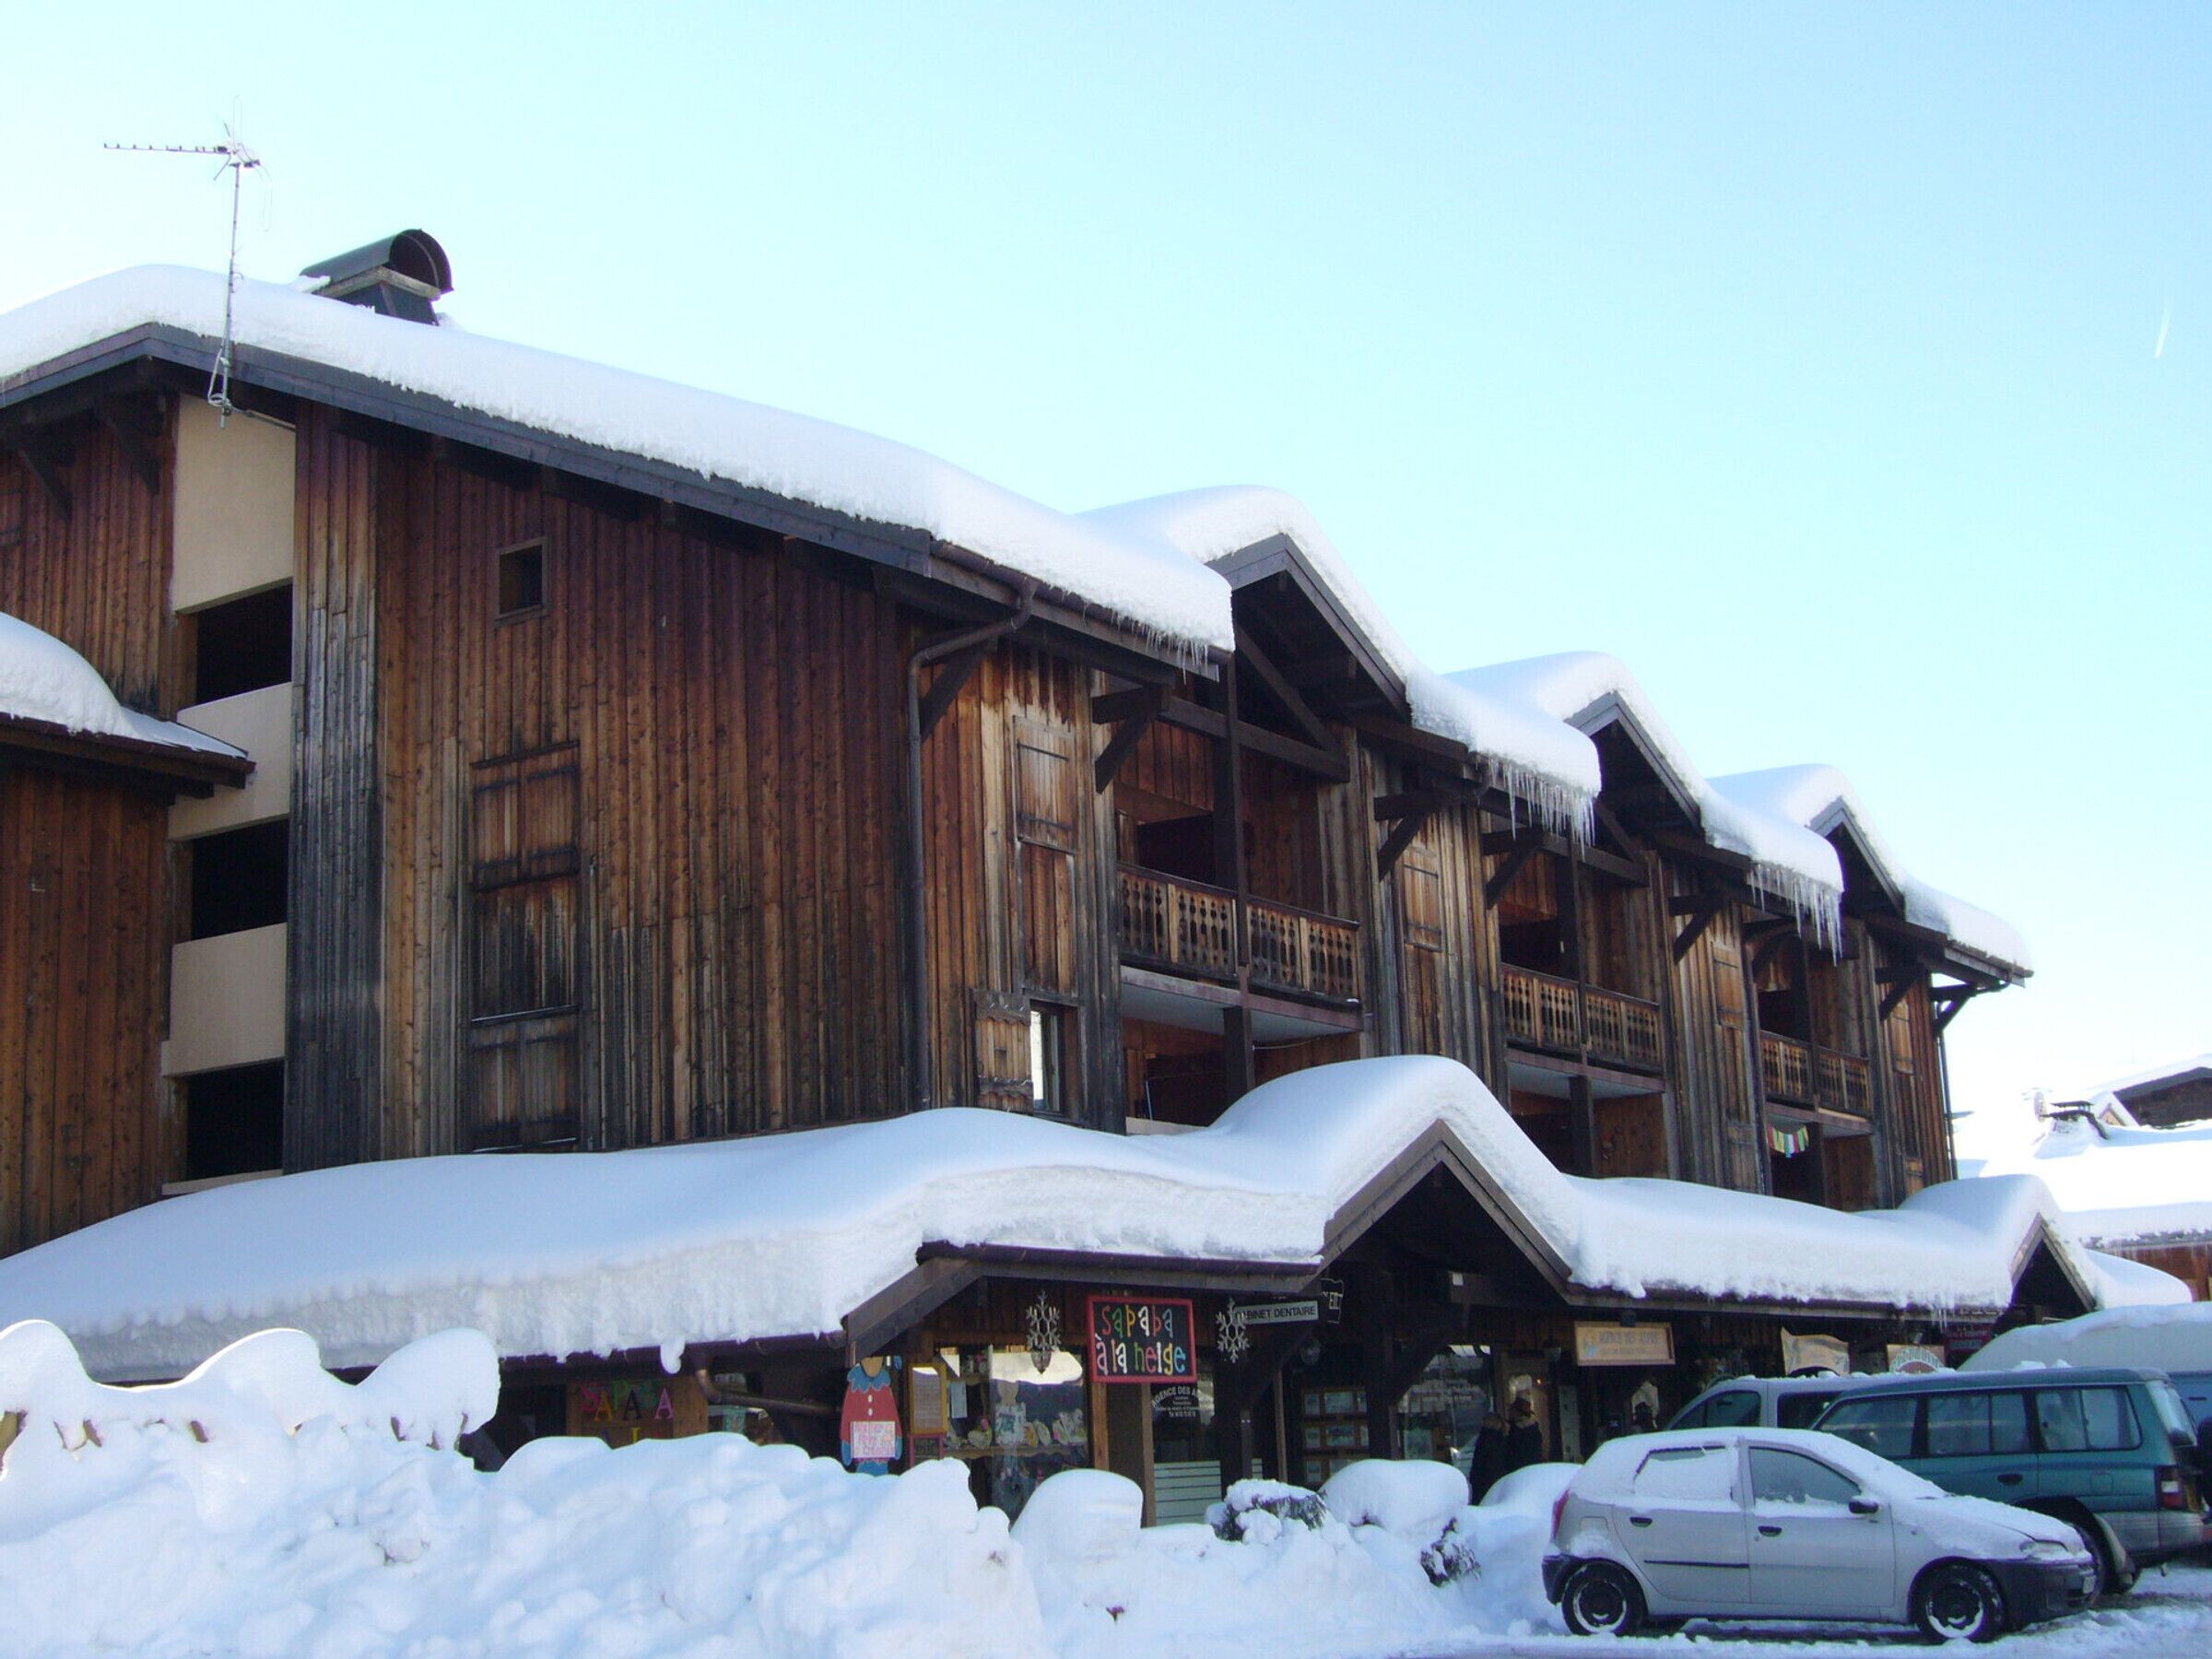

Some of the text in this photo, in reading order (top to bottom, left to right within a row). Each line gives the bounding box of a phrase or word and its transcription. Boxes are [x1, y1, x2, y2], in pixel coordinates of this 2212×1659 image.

[1274, 1305, 1316, 1318] DENTAIRE
[1094, 1333, 1186, 1376] à la neige
